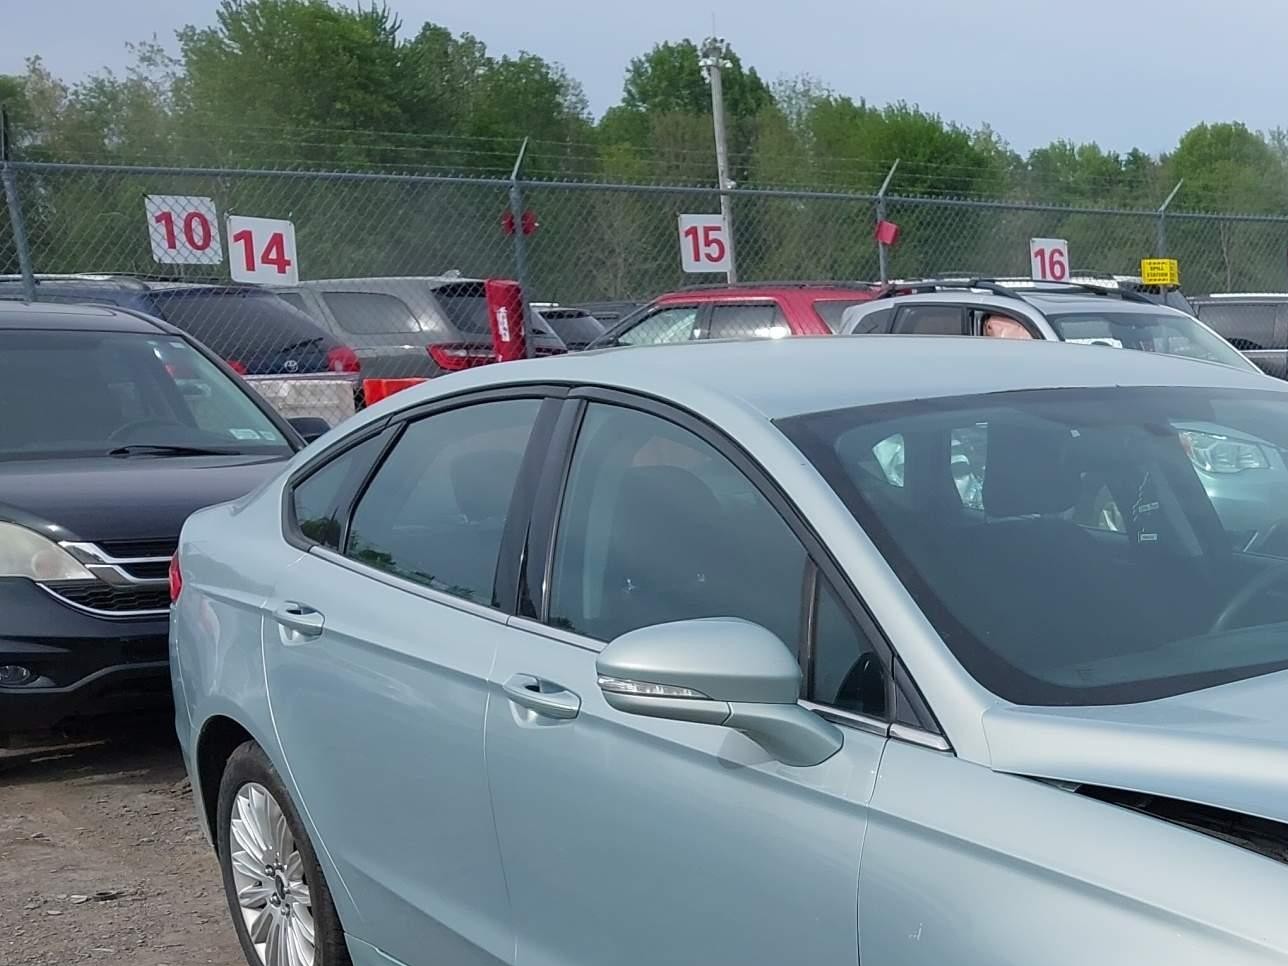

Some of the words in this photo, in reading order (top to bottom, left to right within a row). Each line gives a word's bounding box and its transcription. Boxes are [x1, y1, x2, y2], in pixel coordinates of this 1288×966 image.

[154, 211, 212, 251] 10
[684, 225, 726, 263] 15
[233, 229, 291, 274] 14
[1034, 247, 1066, 281] 16
